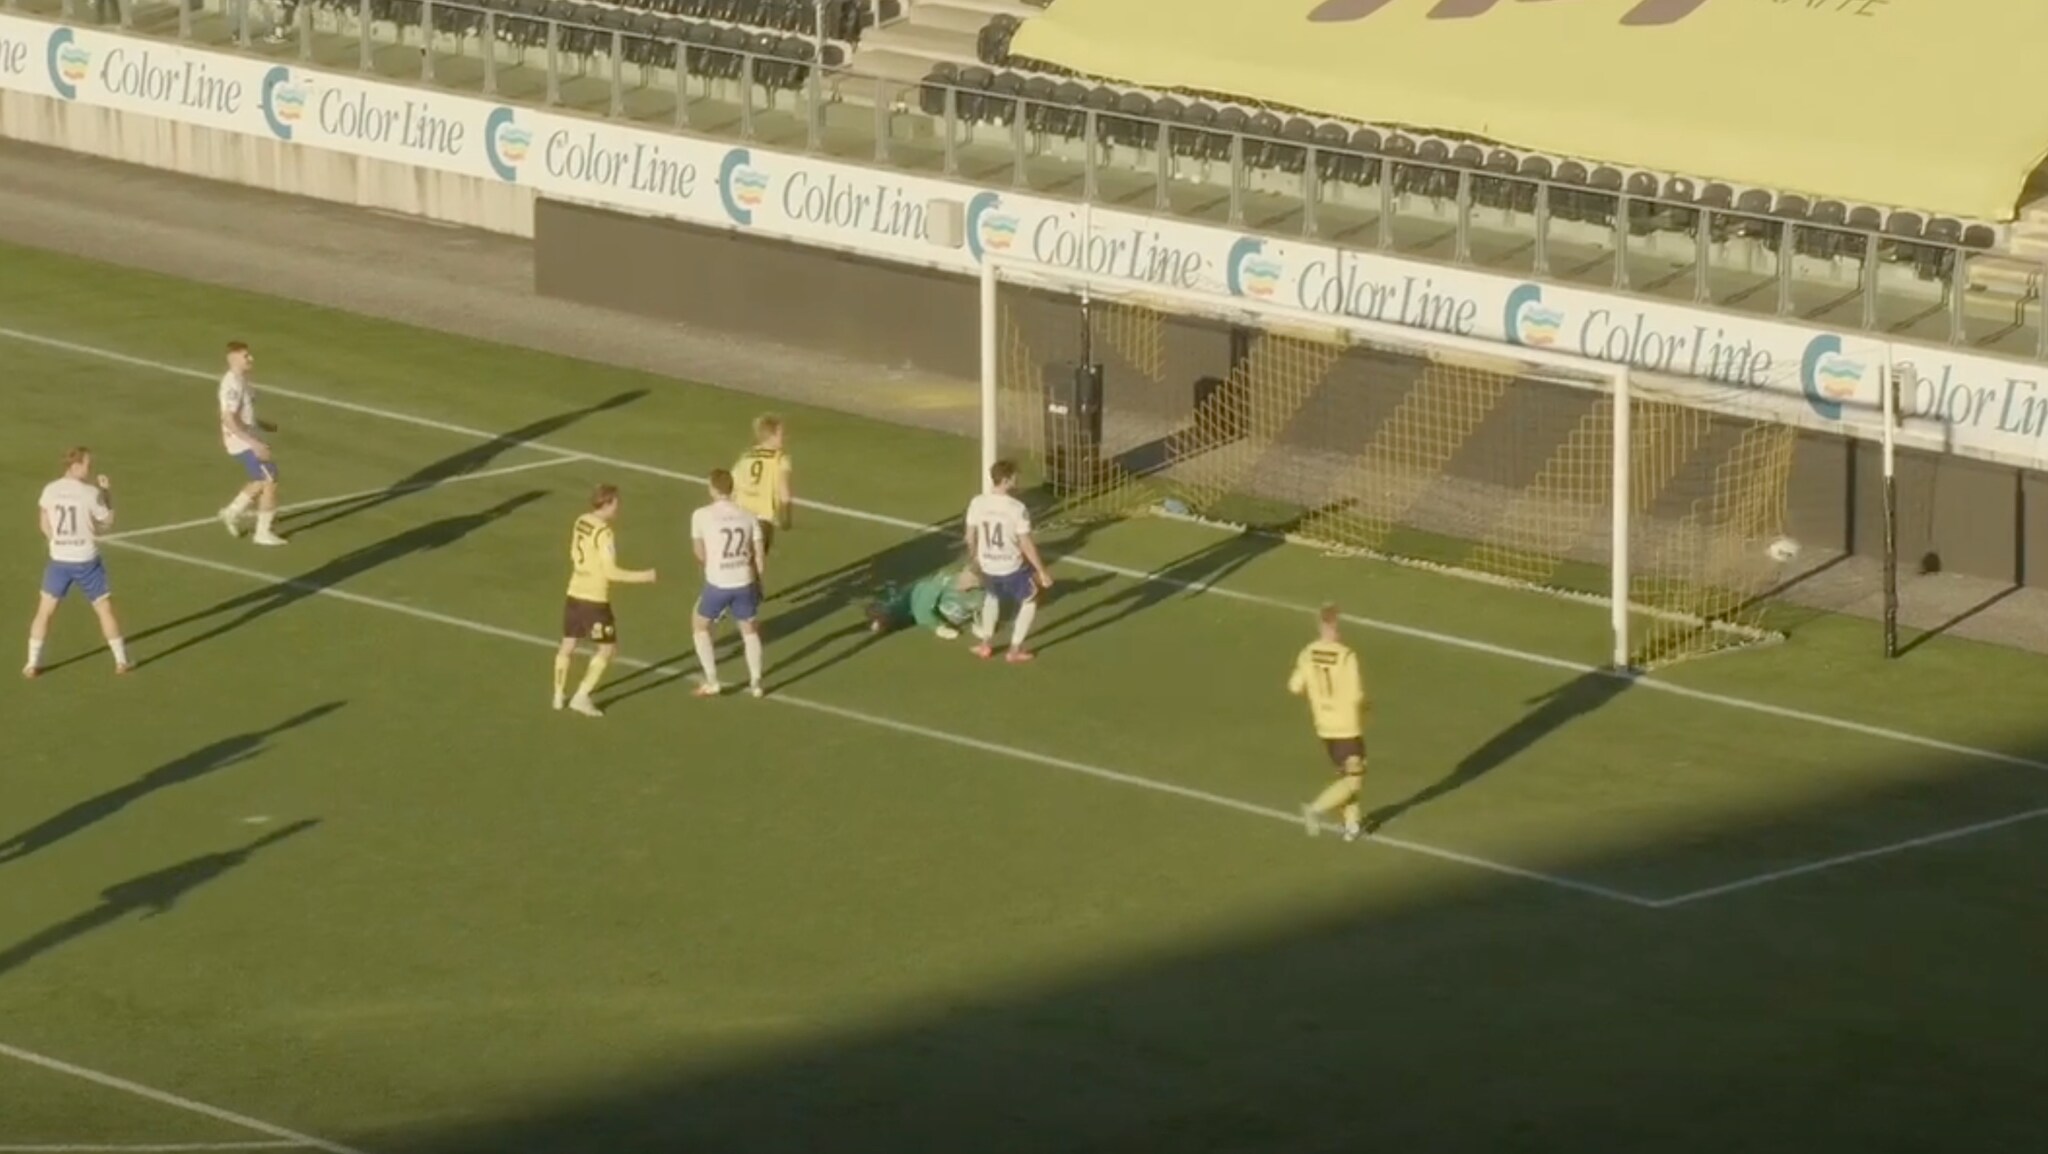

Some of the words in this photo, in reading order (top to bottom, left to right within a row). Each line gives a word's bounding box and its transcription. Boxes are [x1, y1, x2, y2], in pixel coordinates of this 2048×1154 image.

[0, 38, 27, 74] ne
[1897, 360, 1996, 428] olor
[750, 459, 764, 485] 9
[55, 504, 77, 536] 21
[982, 520, 1005, 549] 14
[719, 526, 748, 559] 22
